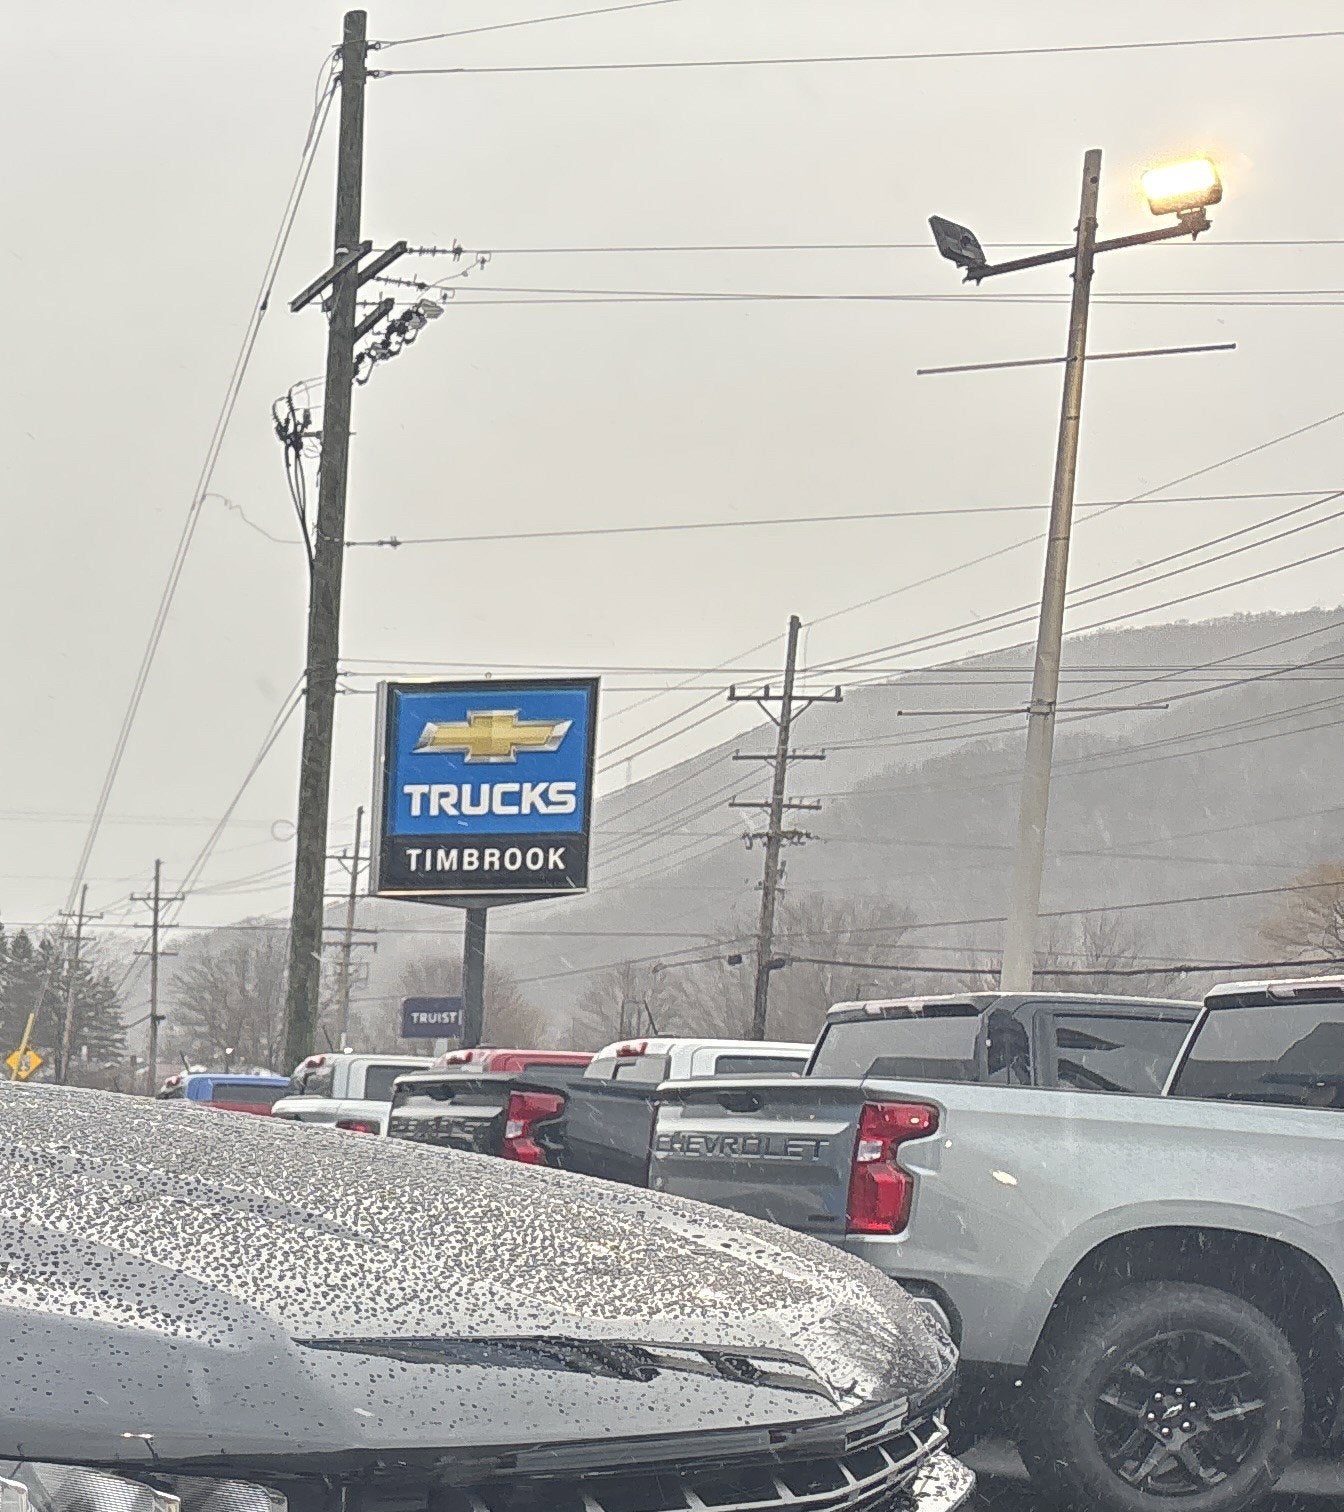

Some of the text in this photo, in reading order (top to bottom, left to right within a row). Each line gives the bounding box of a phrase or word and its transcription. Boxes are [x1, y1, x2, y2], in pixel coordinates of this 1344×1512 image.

[403, 781, 577, 817] TRUCKS
[406, 846, 567, 873] TIMBROOK
[410, 1010, 458, 1025] TRUIST
[656, 1133, 831, 1161] CHEVROLET
